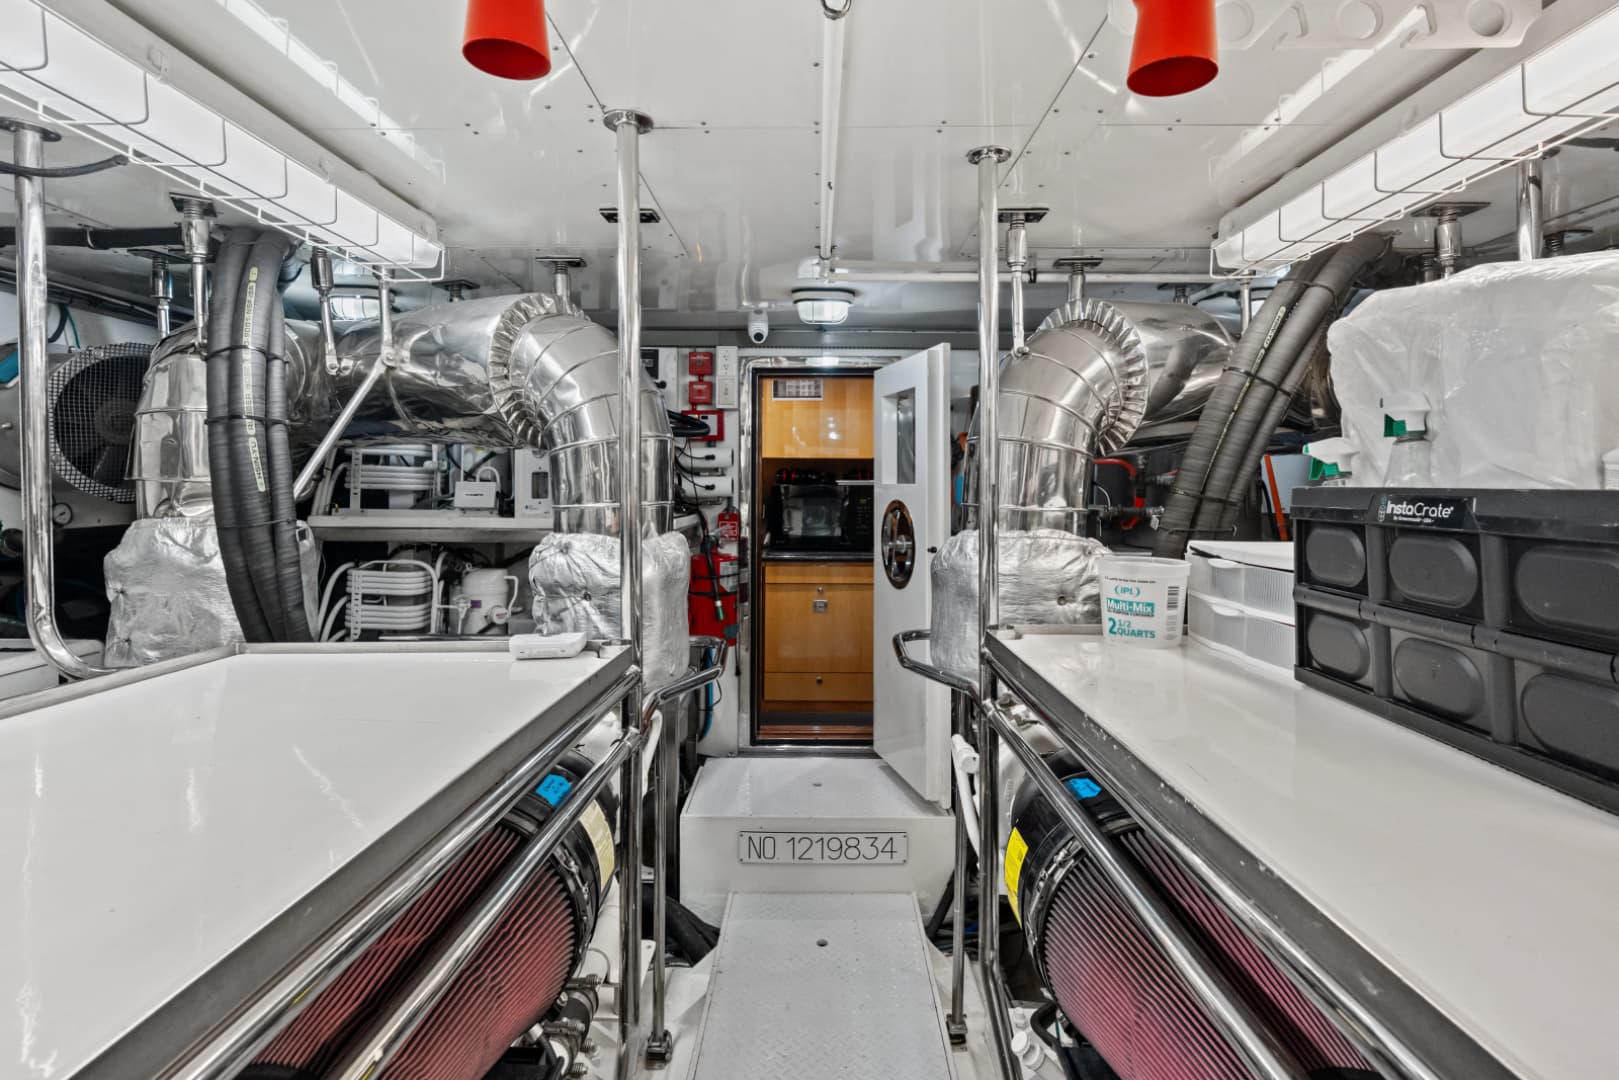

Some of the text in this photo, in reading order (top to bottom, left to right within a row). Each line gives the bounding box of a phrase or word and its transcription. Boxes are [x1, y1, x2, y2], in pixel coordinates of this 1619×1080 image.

[1107, 599, 1154, 613] Multi-Mix
[1108, 617, 1117, 635] 2
[1117, 627, 1156, 639] QUARTS
[786, 836, 898, 861] 1219834
